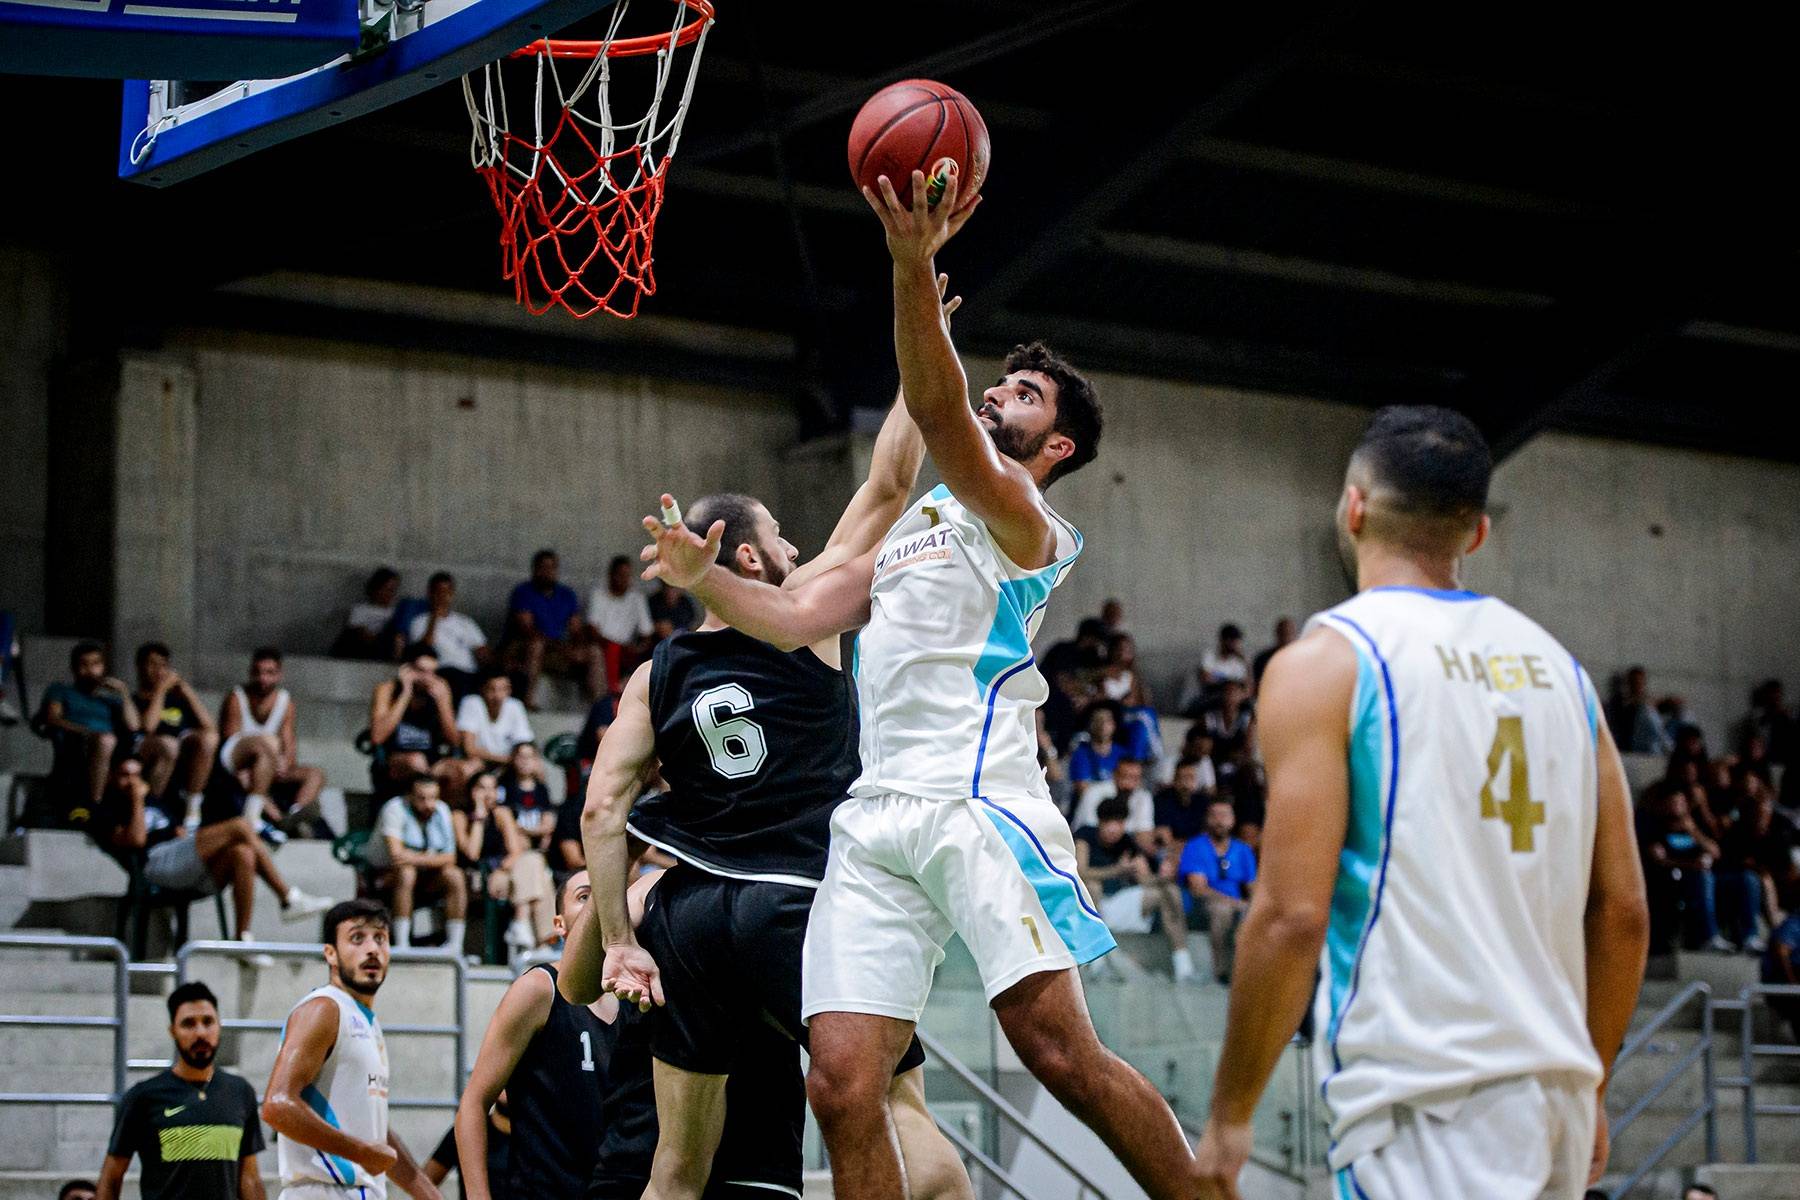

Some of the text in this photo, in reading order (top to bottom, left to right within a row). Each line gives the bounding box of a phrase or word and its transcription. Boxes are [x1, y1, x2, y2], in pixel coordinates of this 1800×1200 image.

[1435, 644, 1553, 692] HAGE
[691, 682, 768, 779] 6
[1480, 716, 1545, 853] 4
[1020, 915, 1045, 955] 1
[580, 1031, 595, 1071] 1
